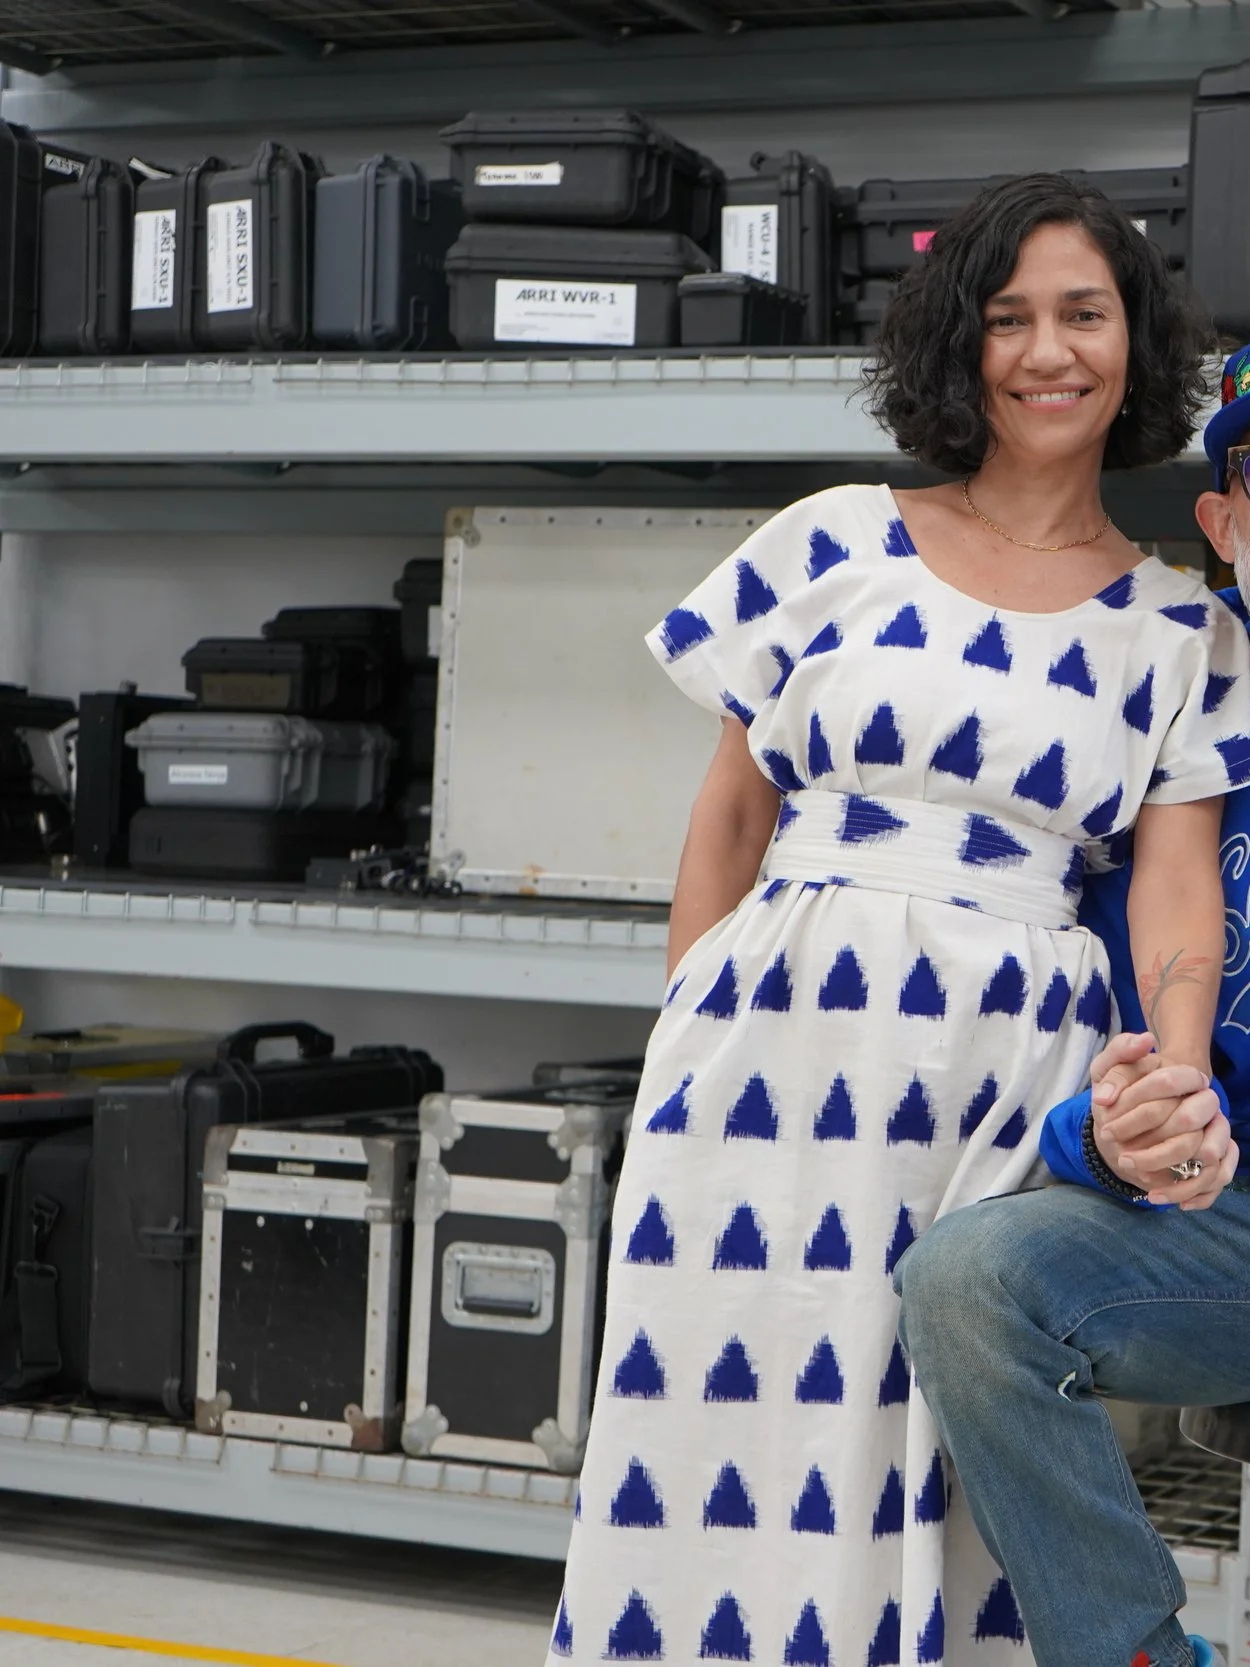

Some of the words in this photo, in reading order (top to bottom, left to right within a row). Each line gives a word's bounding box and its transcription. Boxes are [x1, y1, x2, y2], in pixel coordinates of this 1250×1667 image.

[159, 216, 172, 253] ARRI
[236, 205, 249, 247] ARRI
[236, 252, 249, 305] SXU-1
[515, 287, 556, 302] ARRI
[562, 288, 617, 305] WVR-1
